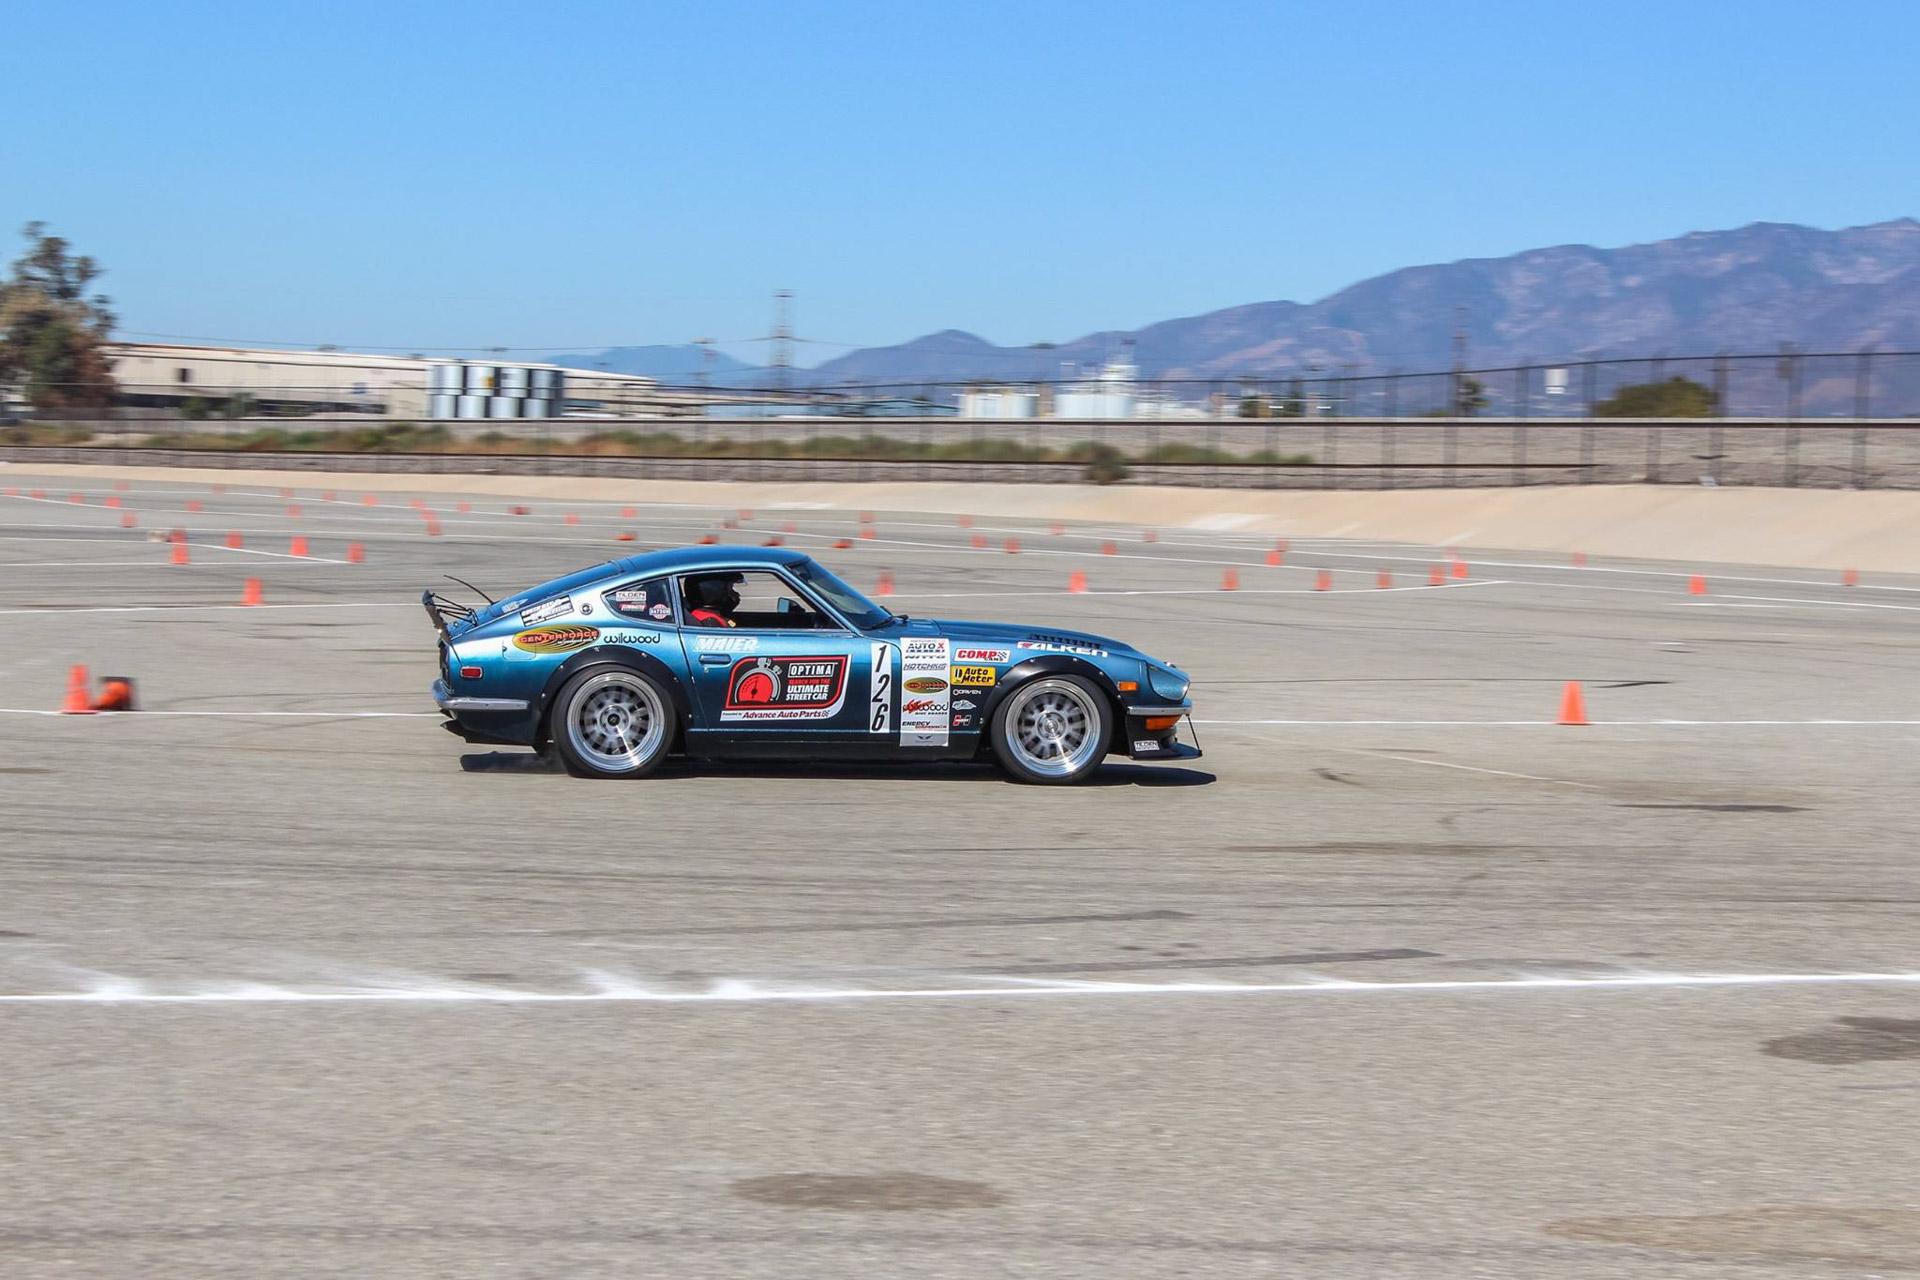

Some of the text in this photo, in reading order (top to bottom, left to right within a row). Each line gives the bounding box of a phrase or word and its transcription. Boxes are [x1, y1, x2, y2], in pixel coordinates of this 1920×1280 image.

[519, 630, 598, 644] CENTERFORCE
[603, 632, 661, 644] wilwood
[694, 637, 759, 652] MAIER
[1017, 641, 1108, 658] FALKEN
[957, 650, 998, 659] COMP
[790, 664, 832, 676] OPTIMA
[961, 675, 993, 683] Meter
[787, 685, 829, 693] ULTIMATE
[786, 693, 811, 701] STREET
[742, 711, 777, 719] Advance
[799, 710, 822, 718] Parts
